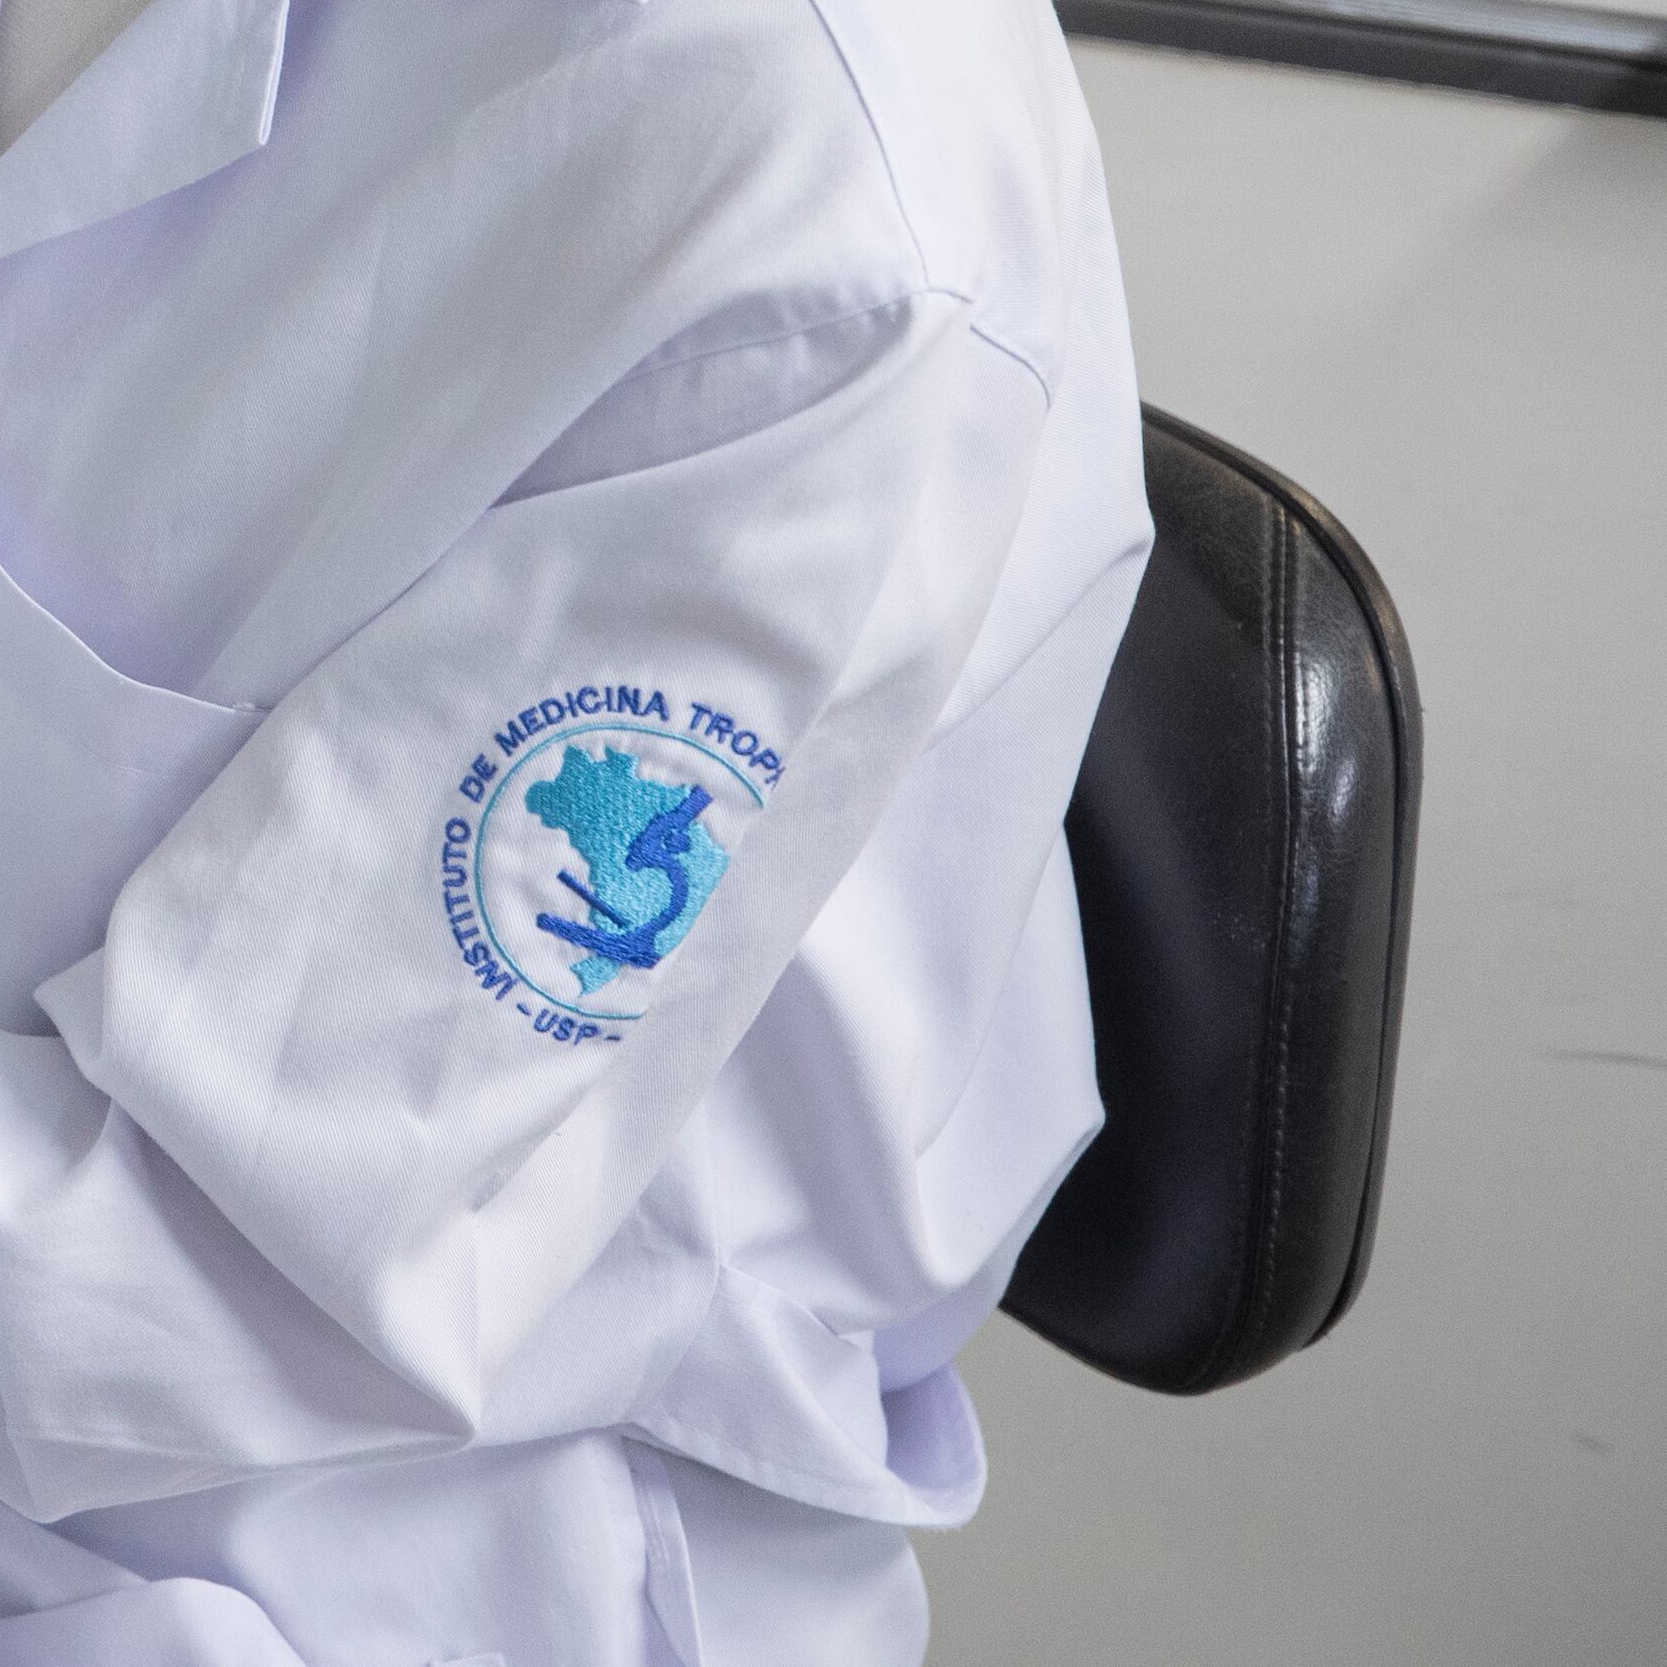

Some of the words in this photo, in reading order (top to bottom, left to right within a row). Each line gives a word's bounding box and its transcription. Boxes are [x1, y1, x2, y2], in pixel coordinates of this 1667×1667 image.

[493, 685, 669, 757] MEDICINA
[458, 753, 499, 804] DE
[442, 816, 516, 1002] INSTITUTO
